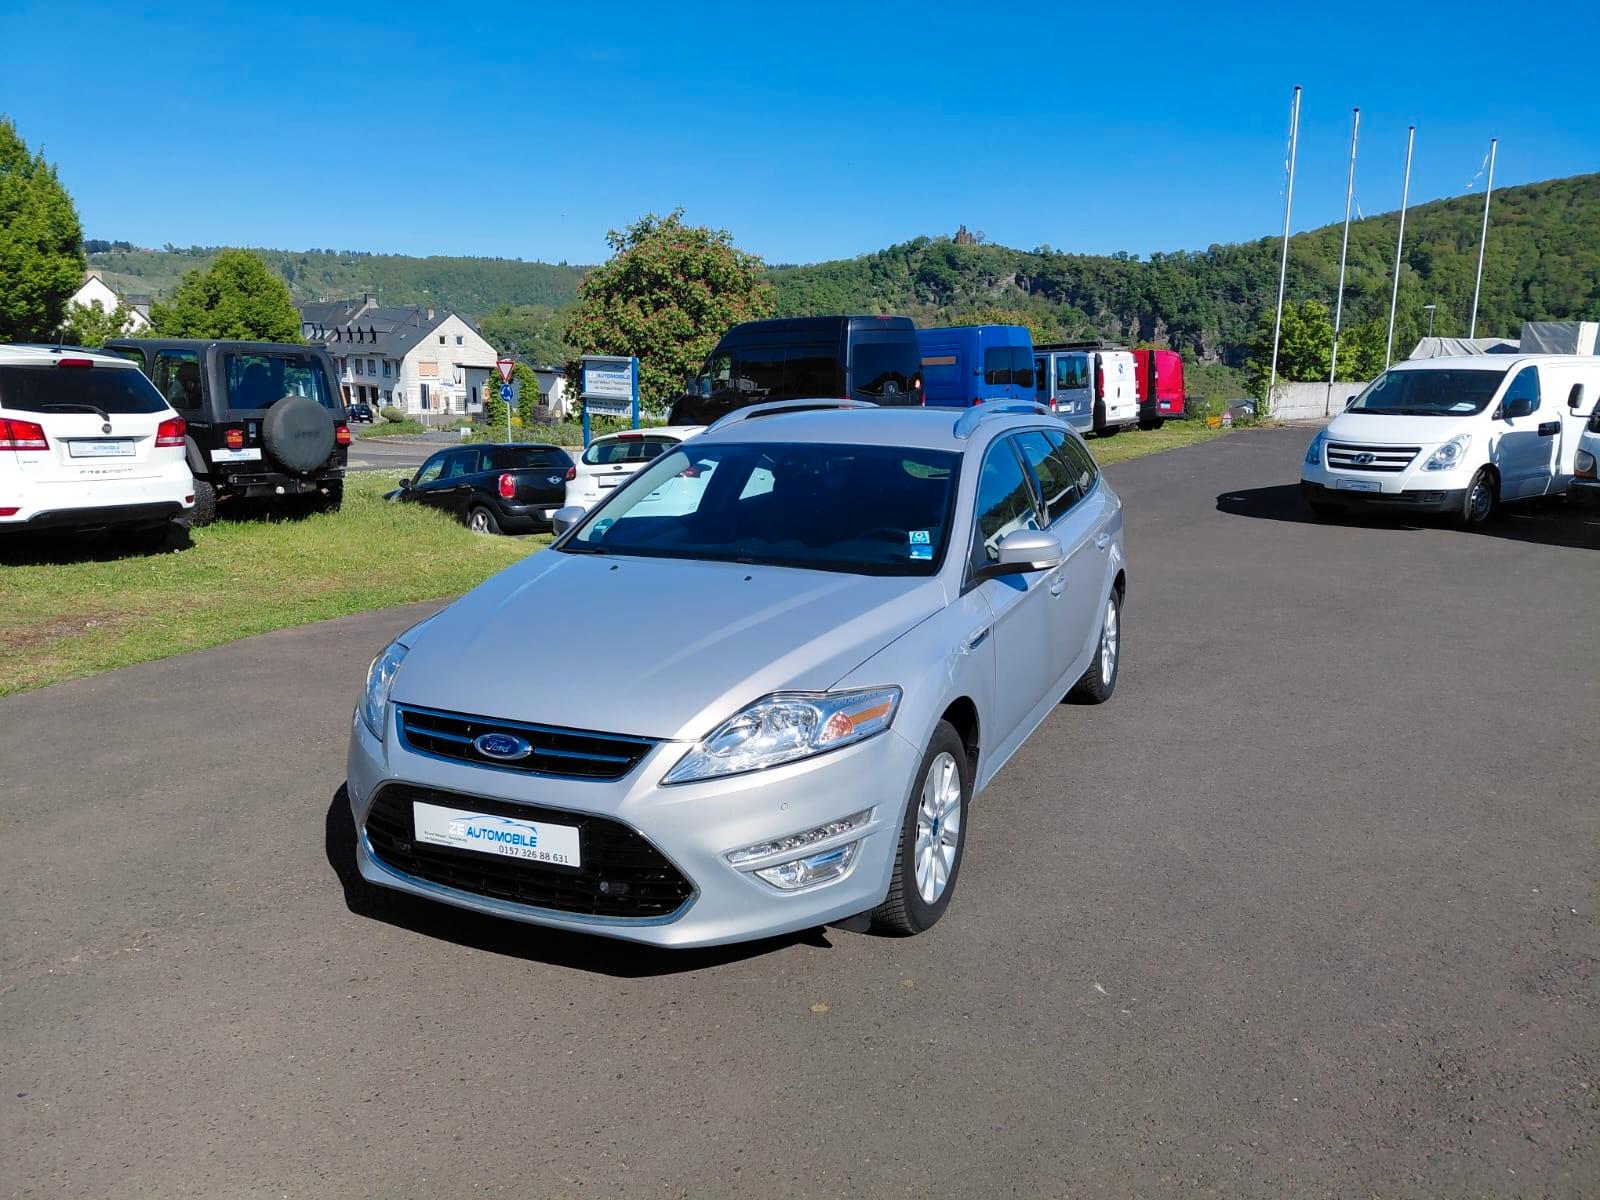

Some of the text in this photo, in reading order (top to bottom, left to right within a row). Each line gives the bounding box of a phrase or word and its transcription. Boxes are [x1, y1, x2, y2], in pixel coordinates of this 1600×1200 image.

[485, 740, 511, 752] Ford
[466, 826, 537, 848] AUTOMOBILE
[498, 845, 569, 863] 0157 326 88 631
